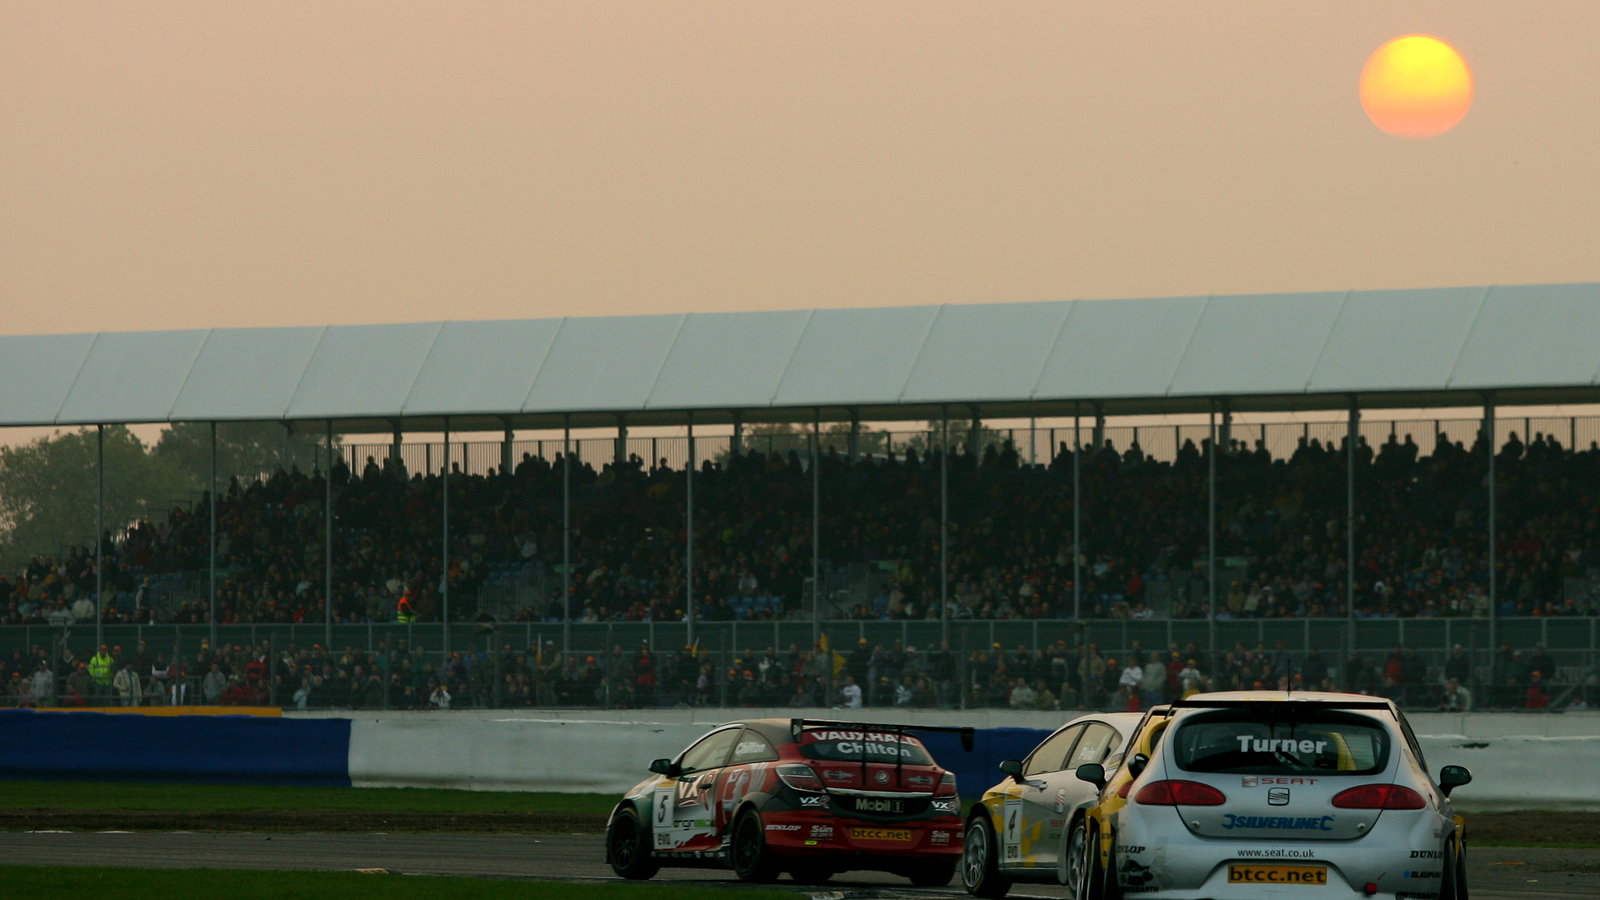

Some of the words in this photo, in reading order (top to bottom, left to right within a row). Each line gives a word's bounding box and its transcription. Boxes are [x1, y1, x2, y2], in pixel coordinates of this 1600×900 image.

[811, 730, 918, 746] VAUXHALL
[1236, 735, 1327, 754] Turner
[836, 742, 911, 757] Chilton
[1261, 777, 1319, 786] SEAT
[658, 795, 669, 823] 5
[800, 795, 831, 810] VXR
[855, 798, 891, 811] Mobil
[1008, 809, 1017, 841] 4
[852, 830, 911, 841] btcc.net
[1237, 849, 1315, 859] www.seat.co.uk
[1230, 867, 1326, 884] btcc.net
